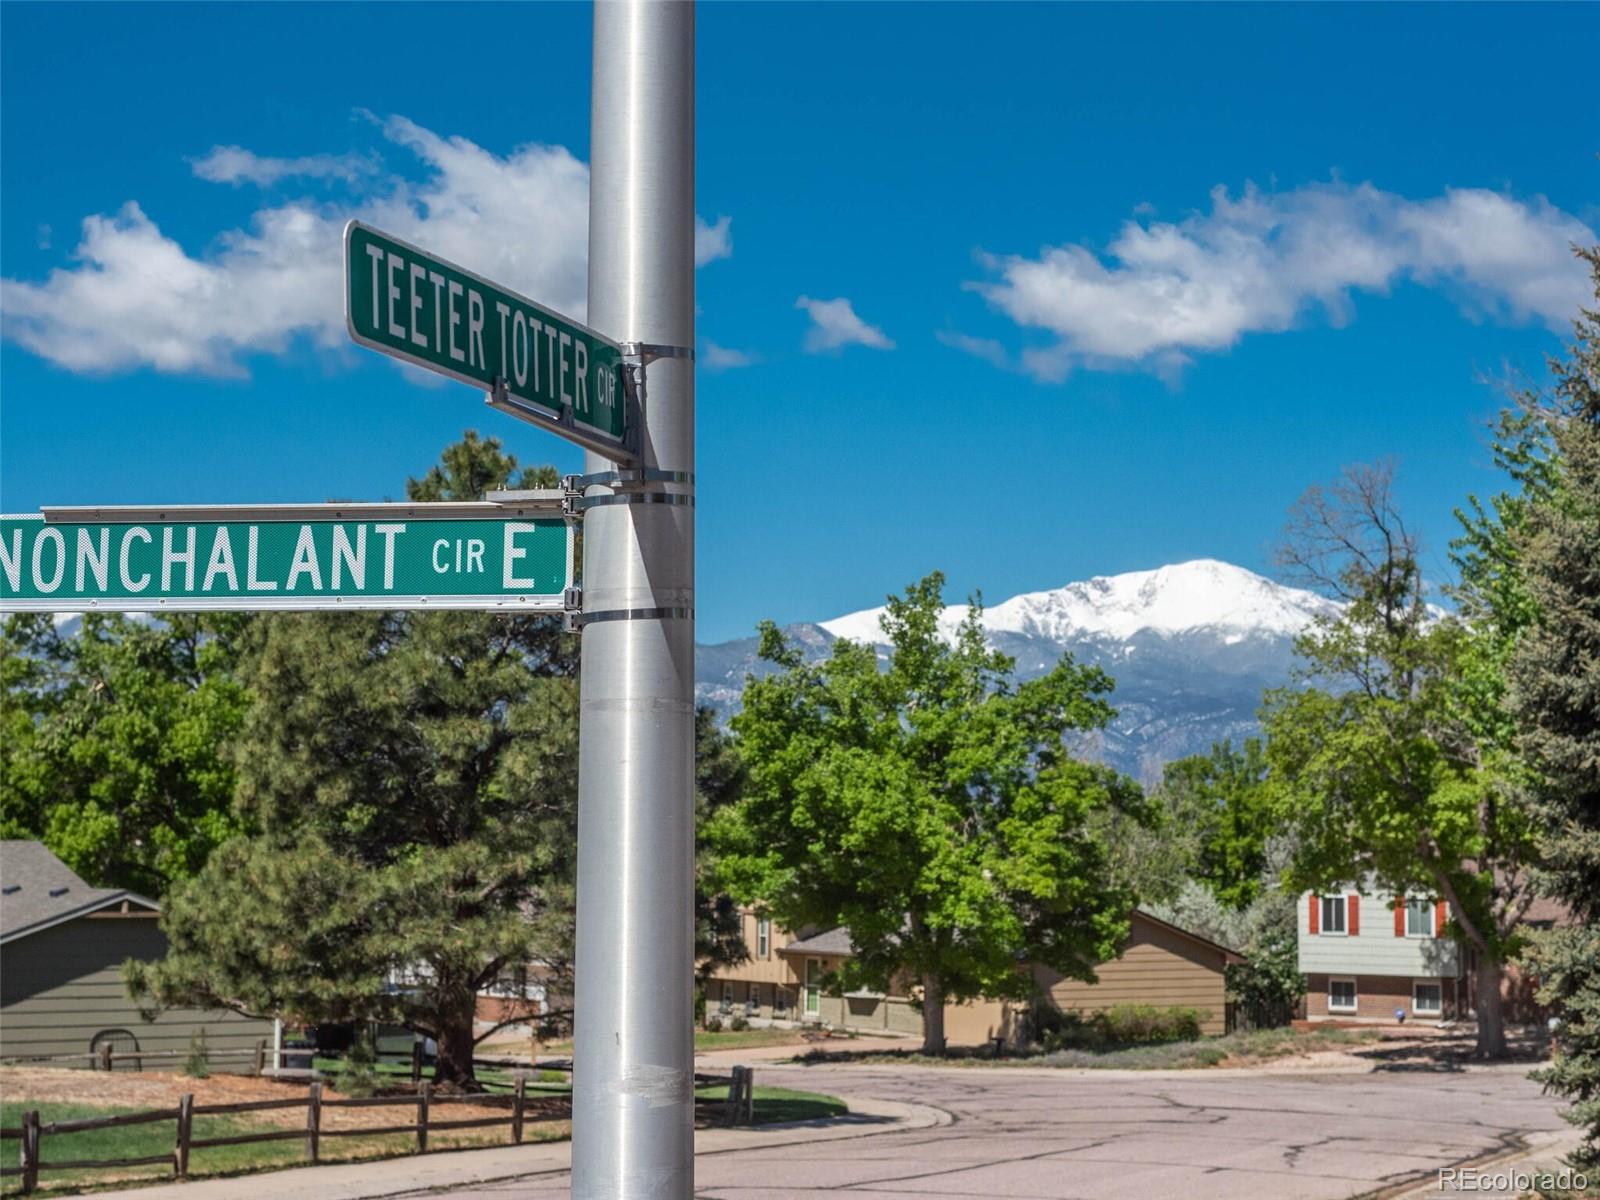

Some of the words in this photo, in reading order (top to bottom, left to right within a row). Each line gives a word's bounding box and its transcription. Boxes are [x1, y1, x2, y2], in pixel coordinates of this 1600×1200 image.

[366, 243, 486, 371] TEETER
[496, 301, 588, 414] TOTTER
[596, 366, 616, 409] CIR
[0, 524, 406, 593] NONCHALANT
[432, 538, 485, 573] CIR
[503, 522, 536, 588] E
